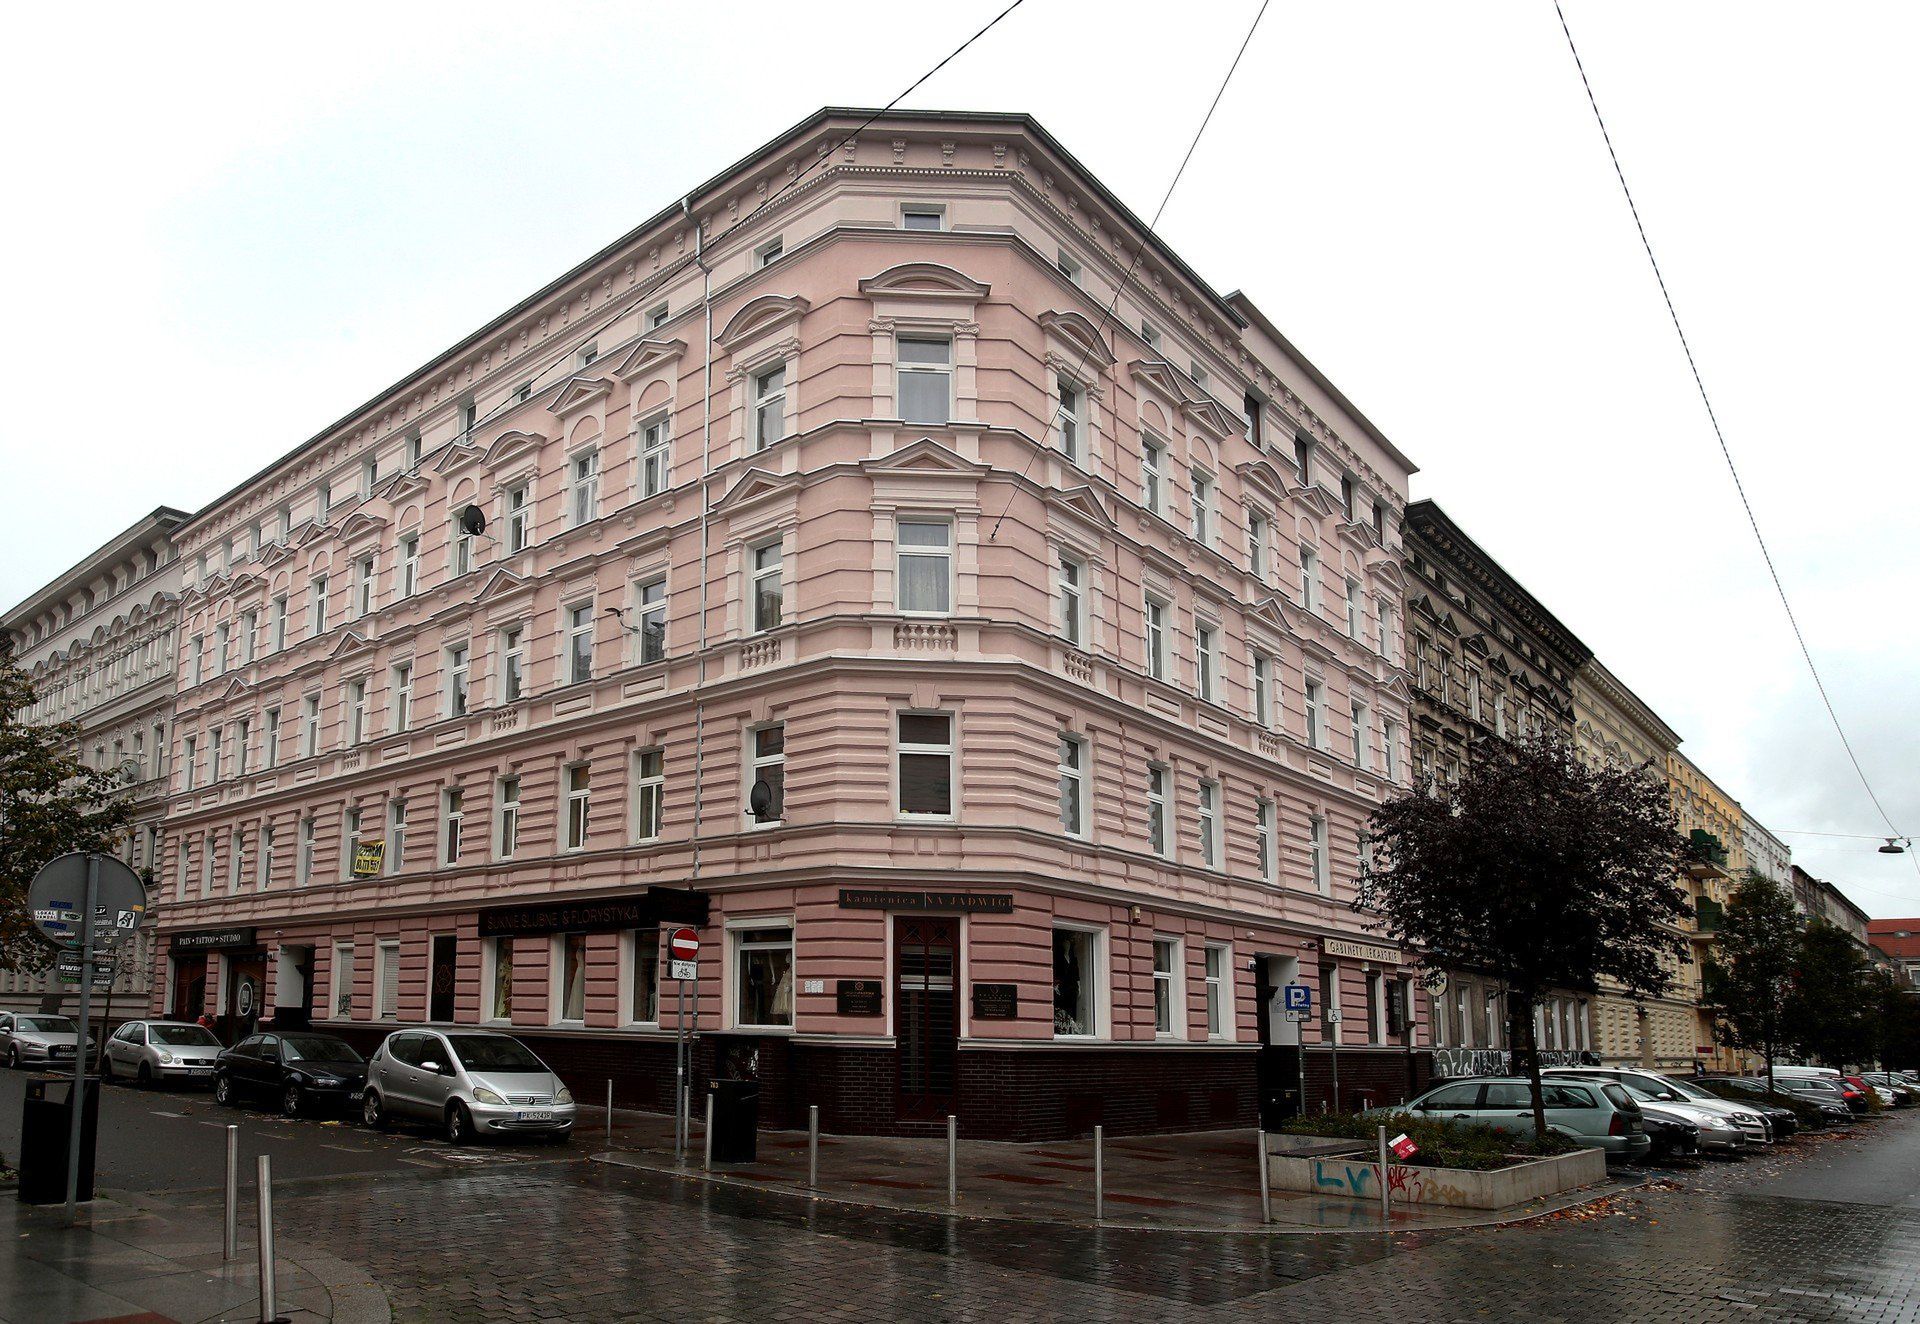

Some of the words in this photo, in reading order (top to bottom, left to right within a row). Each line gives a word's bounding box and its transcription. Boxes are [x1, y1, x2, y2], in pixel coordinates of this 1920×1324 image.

[845, 892, 917, 905] kamienica
[571, 905, 640, 924] FLORYSTYKA
[195, 935, 216, 945] TATTOO
[219, 933, 241, 943] STUDIO
[1329, 941, 1363, 957] GABINETY
